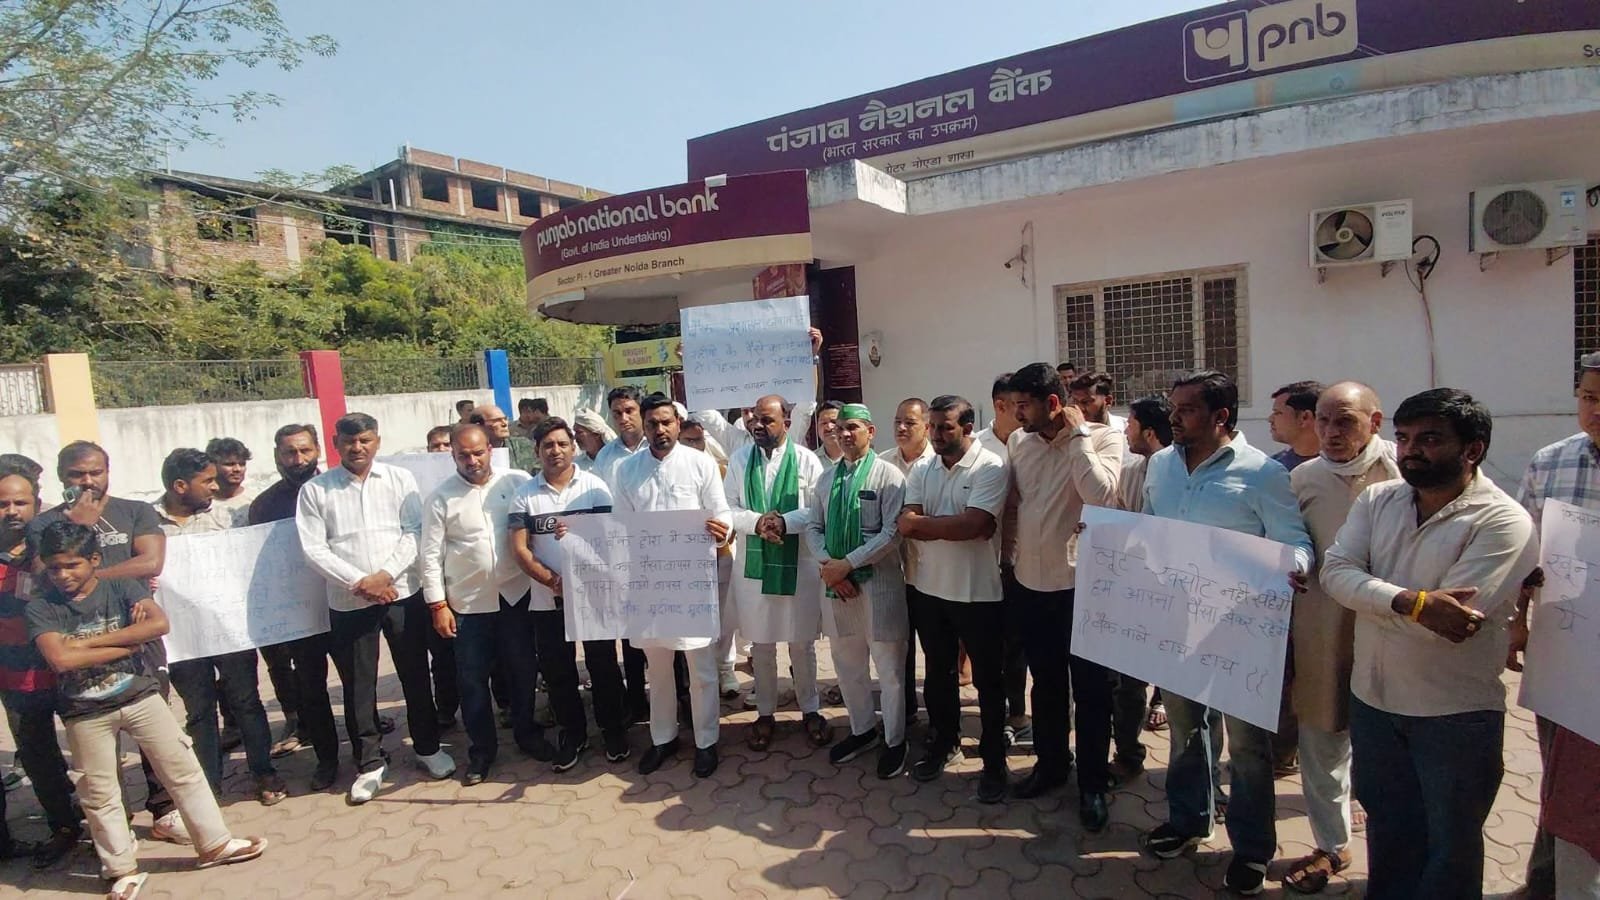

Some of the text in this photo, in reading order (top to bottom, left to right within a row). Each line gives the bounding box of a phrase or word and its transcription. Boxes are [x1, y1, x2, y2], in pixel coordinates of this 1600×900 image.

[1258, 3, 1346, 62] pnb
[766, 67, 1053, 152] पंजाब नैशनल बैंक
[822, 142, 856, 162] (भारत
[862, 132, 902, 151] सरकार
[907, 127, 924, 141] का
[912, 156, 941, 169] नोएडा
[947, 149, 975, 163] शाखा
[536, 189, 719, 255] punjab national bank
[589, 239, 610, 252] India
[611, 227, 672, 249] Undertaking)
[593, 266, 622, 279] Greater
[623, 263, 650, 273] Noida
[650, 256, 686, 270] Branch
